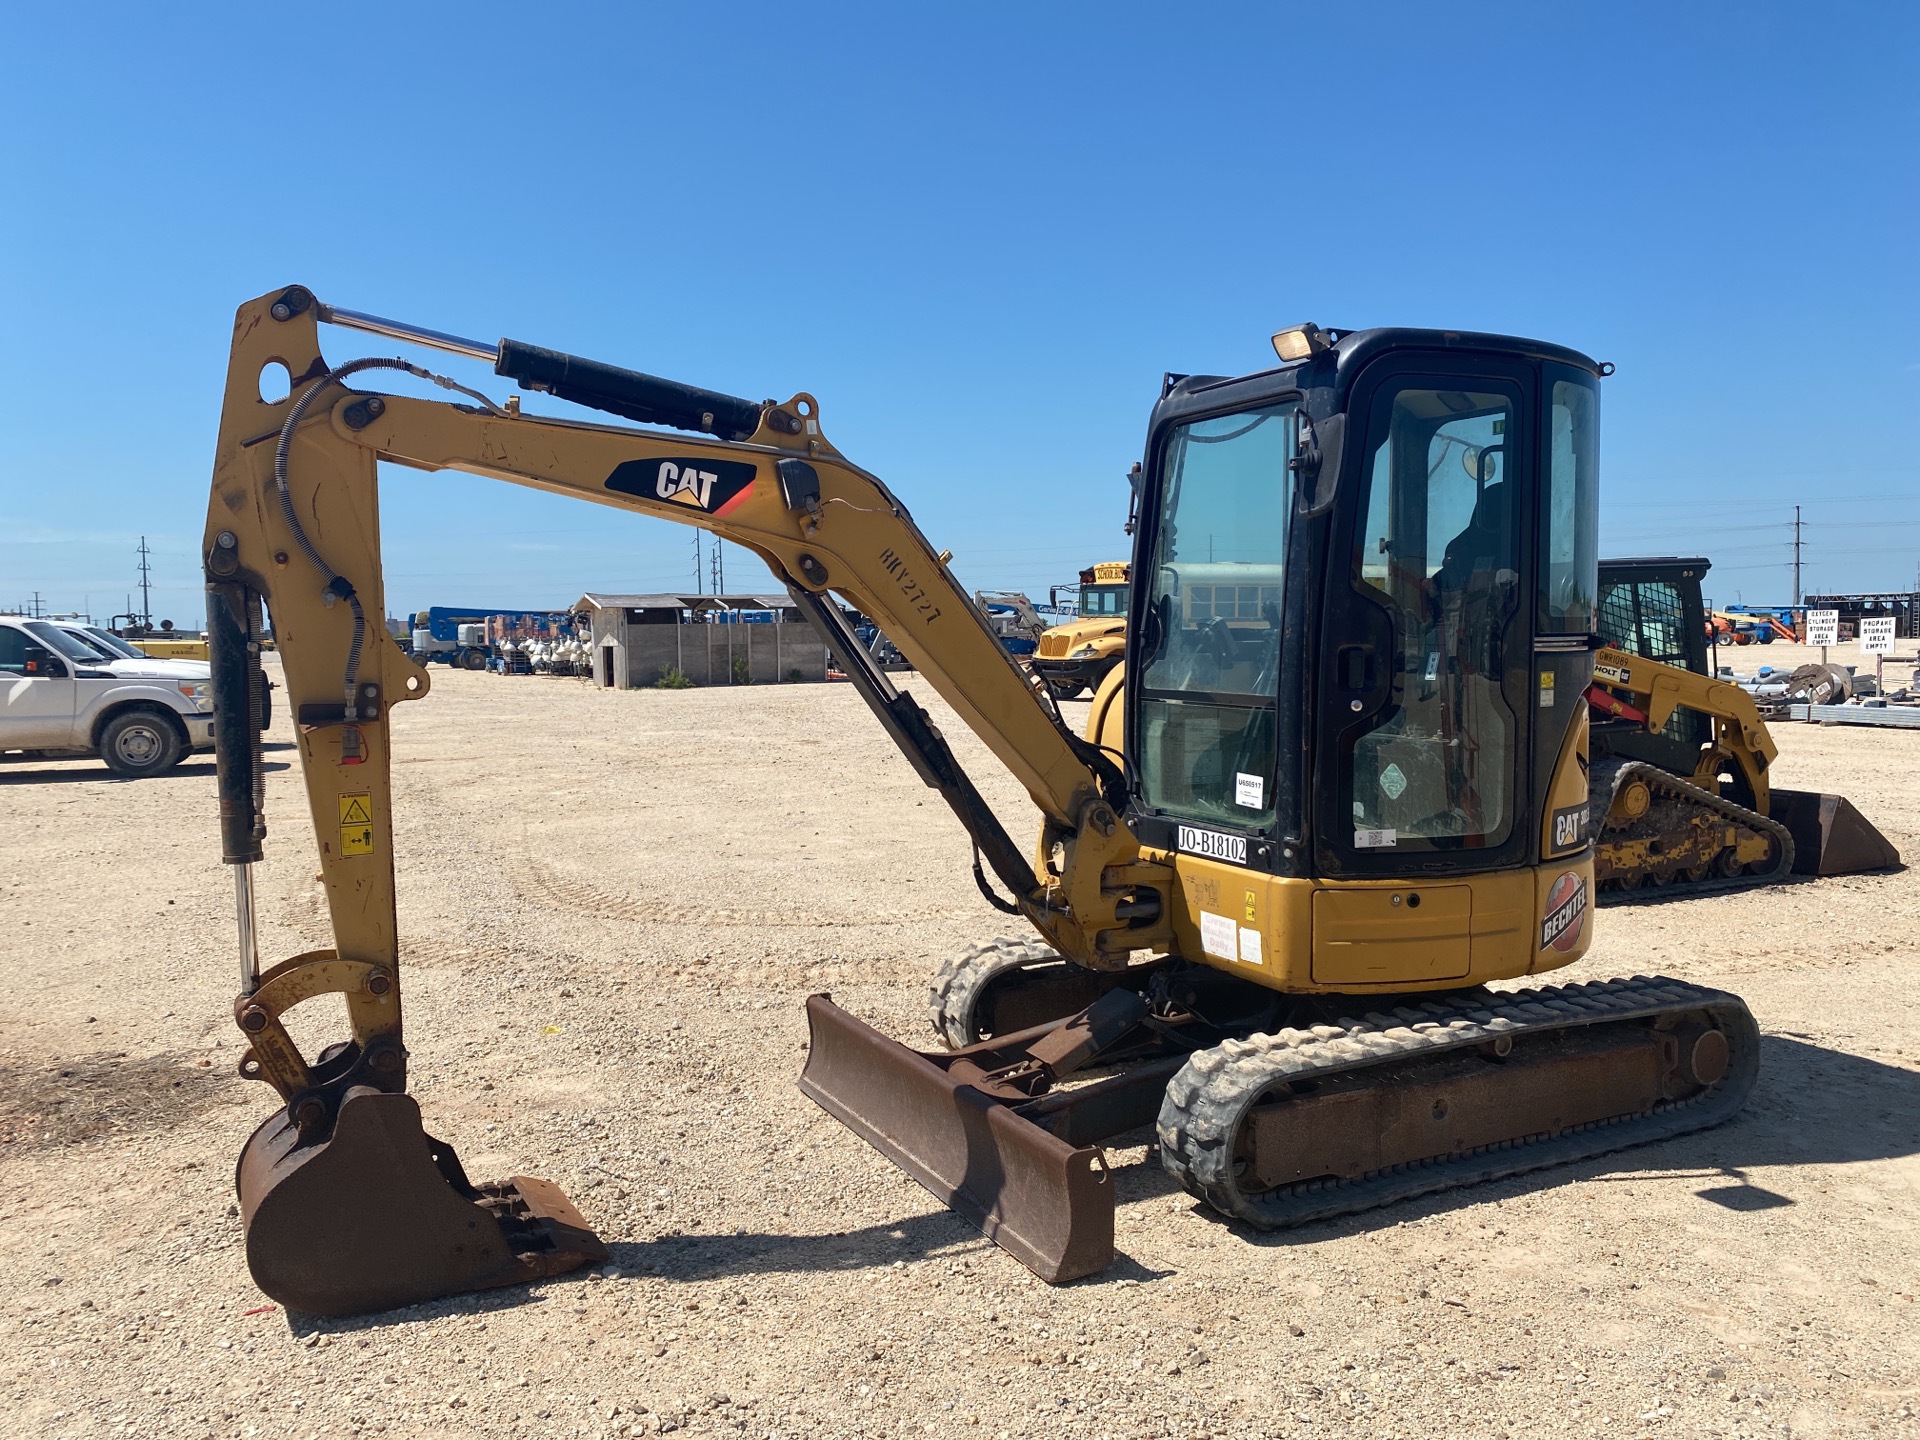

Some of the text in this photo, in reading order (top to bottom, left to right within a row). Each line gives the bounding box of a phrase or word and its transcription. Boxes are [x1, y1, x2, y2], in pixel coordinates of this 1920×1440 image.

[656, 461, 718, 509] CAT
[1097, 568, 1124, 579] SCHOOL BUS
[1594, 665, 1618, 676] HOLT
[1599, 650, 1629, 667] GWR1089
[1621, 672, 1630, 680] CAT
[1556, 812, 1579, 846] CAT
[1180, 827, 1246, 861] JO-B18102
[1543, 886, 1586, 943] BECHTEL
